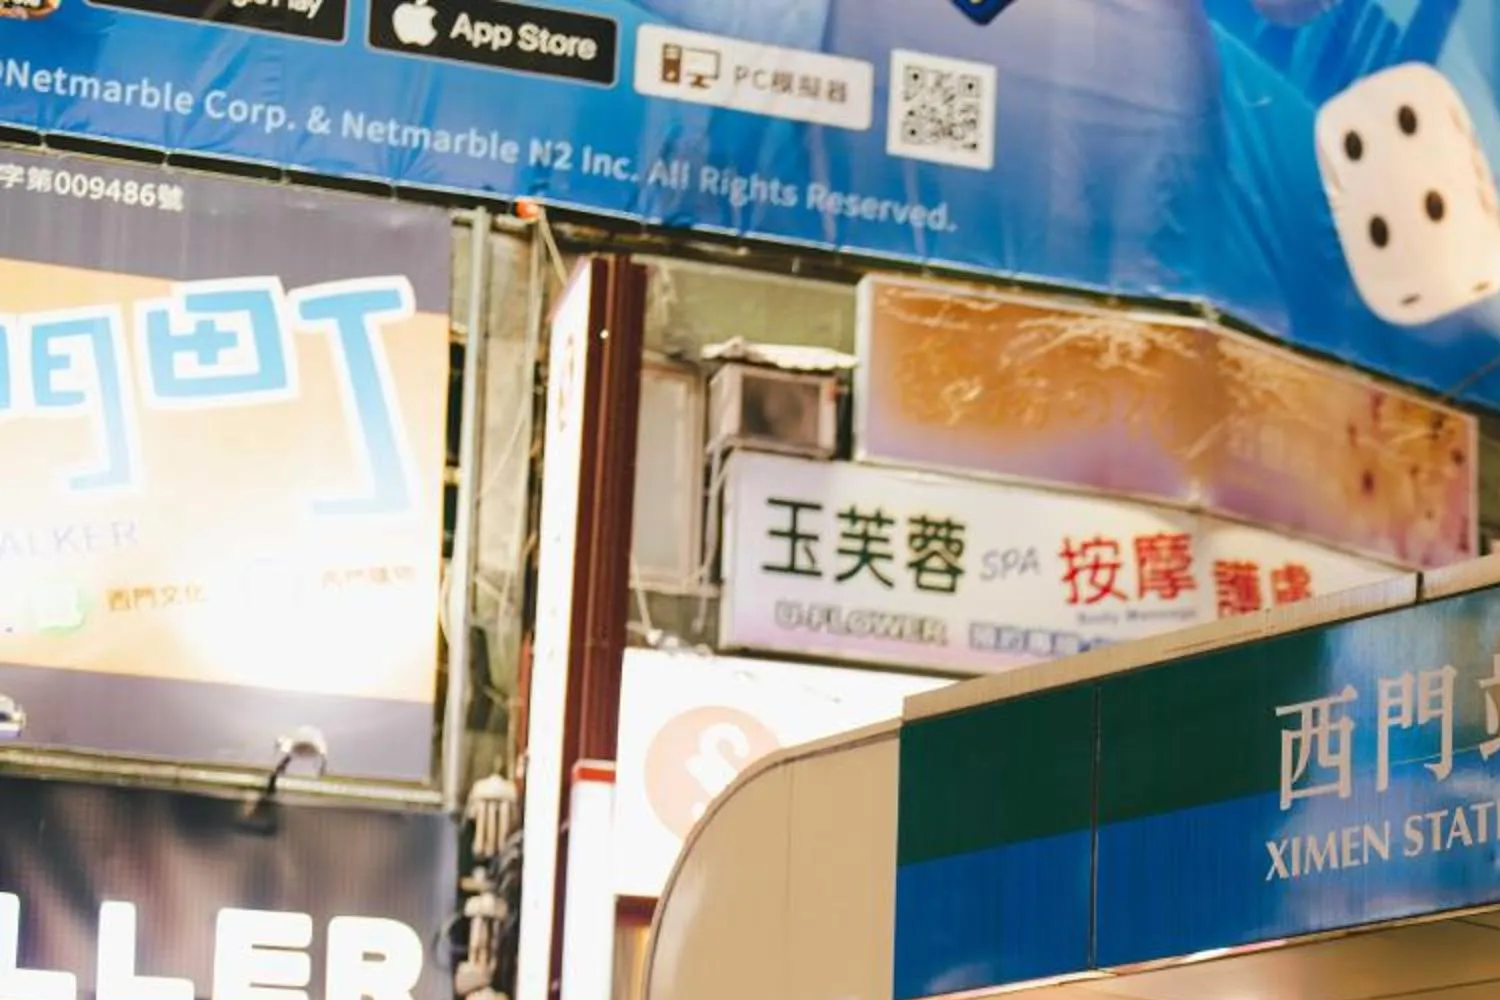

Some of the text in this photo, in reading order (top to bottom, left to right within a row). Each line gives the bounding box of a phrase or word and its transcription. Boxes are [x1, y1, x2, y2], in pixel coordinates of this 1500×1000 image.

[450, 12, 598, 61] App Store
[205, 90, 296, 133] Corp.
[306, 106, 331, 135] &
[341, 110, 520, 164] Netmarble
[528, 139, 573, 171] N2
[581, 153, 639, 181] Inc.
[648, 159, 690, 190] All
[700, 165, 798, 207] Rights
[806, 182, 958, 233] Reserved.
[761, 496, 967, 594] 玉芙蓉
[978, 546, 1042, 582] SPA
[1058, 531, 1197, 606] 按摩
[1265, 819, 1392, 882] XIMEN
